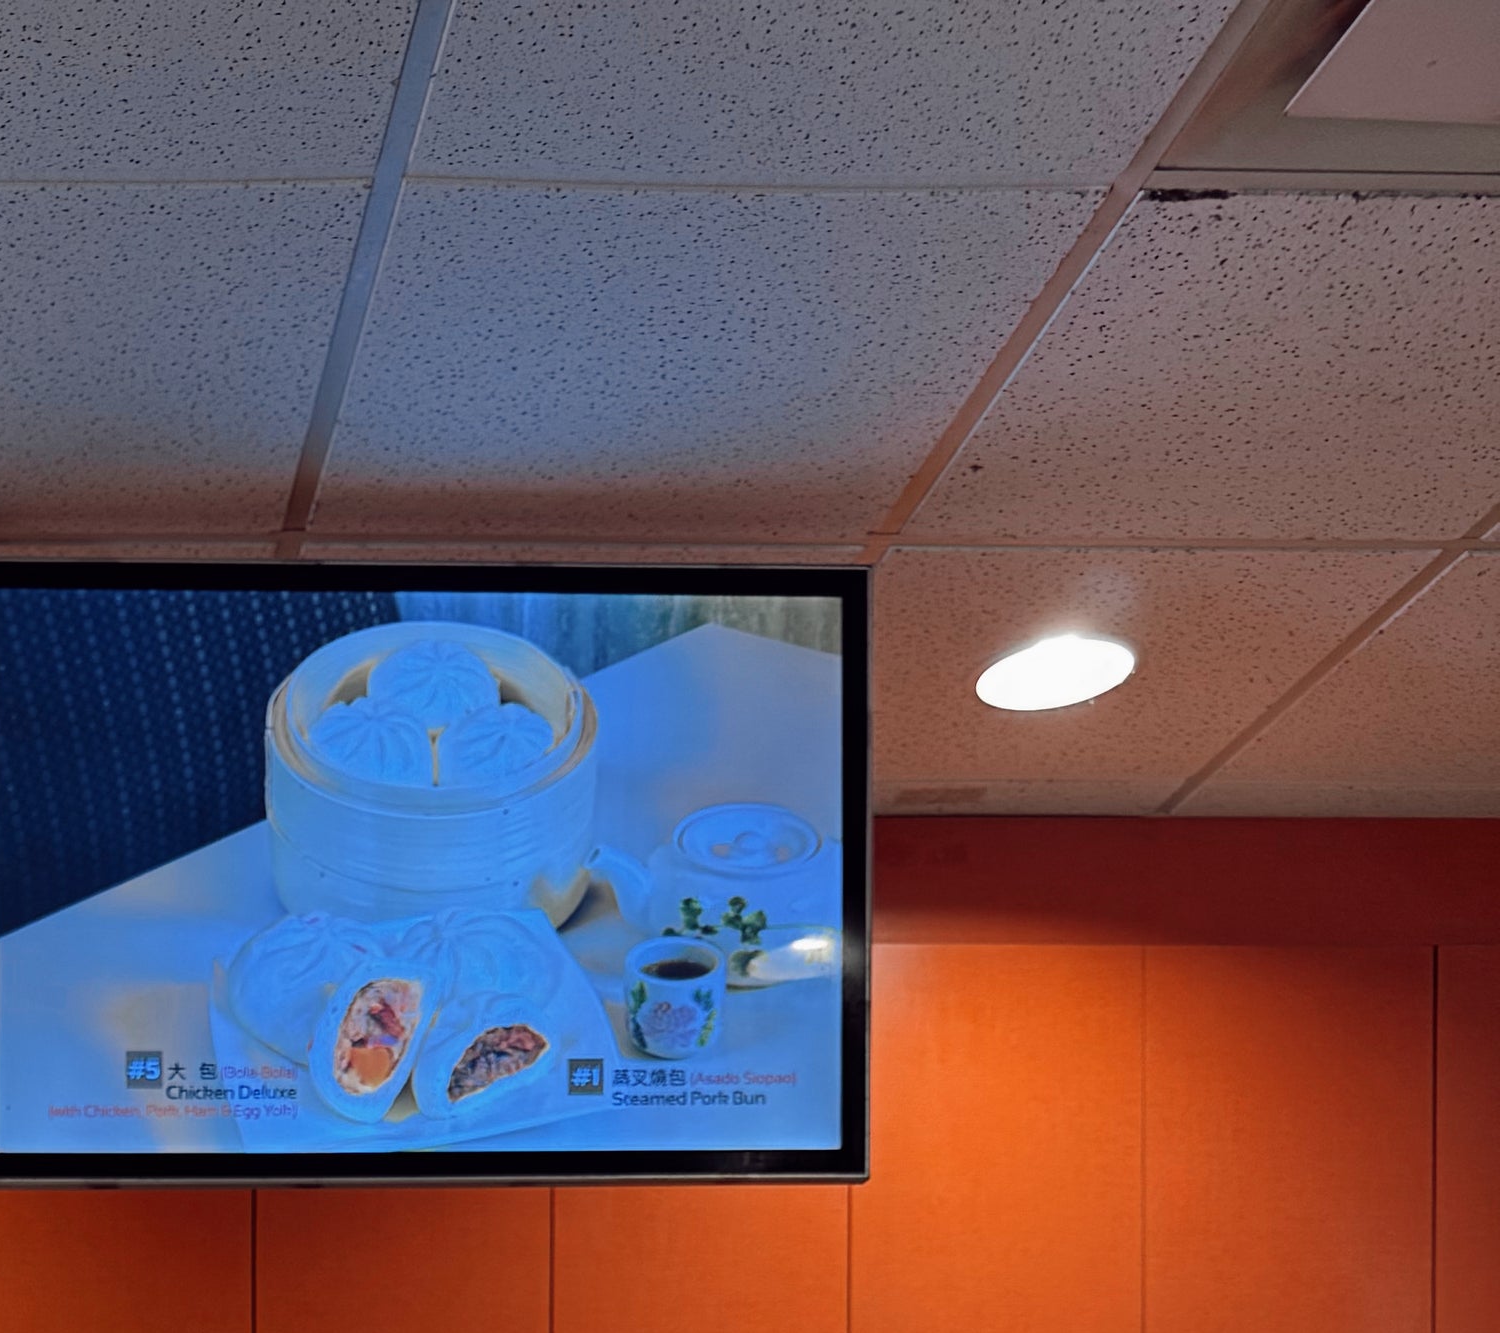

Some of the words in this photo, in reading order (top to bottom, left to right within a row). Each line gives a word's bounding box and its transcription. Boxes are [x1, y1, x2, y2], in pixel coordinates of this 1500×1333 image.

[127, 1056, 161, 1081] #5
[165, 1085, 235, 1101] Chicken
[238, 1084, 297, 1101] Deluxe
[733, 1091, 766, 1106] Bun
